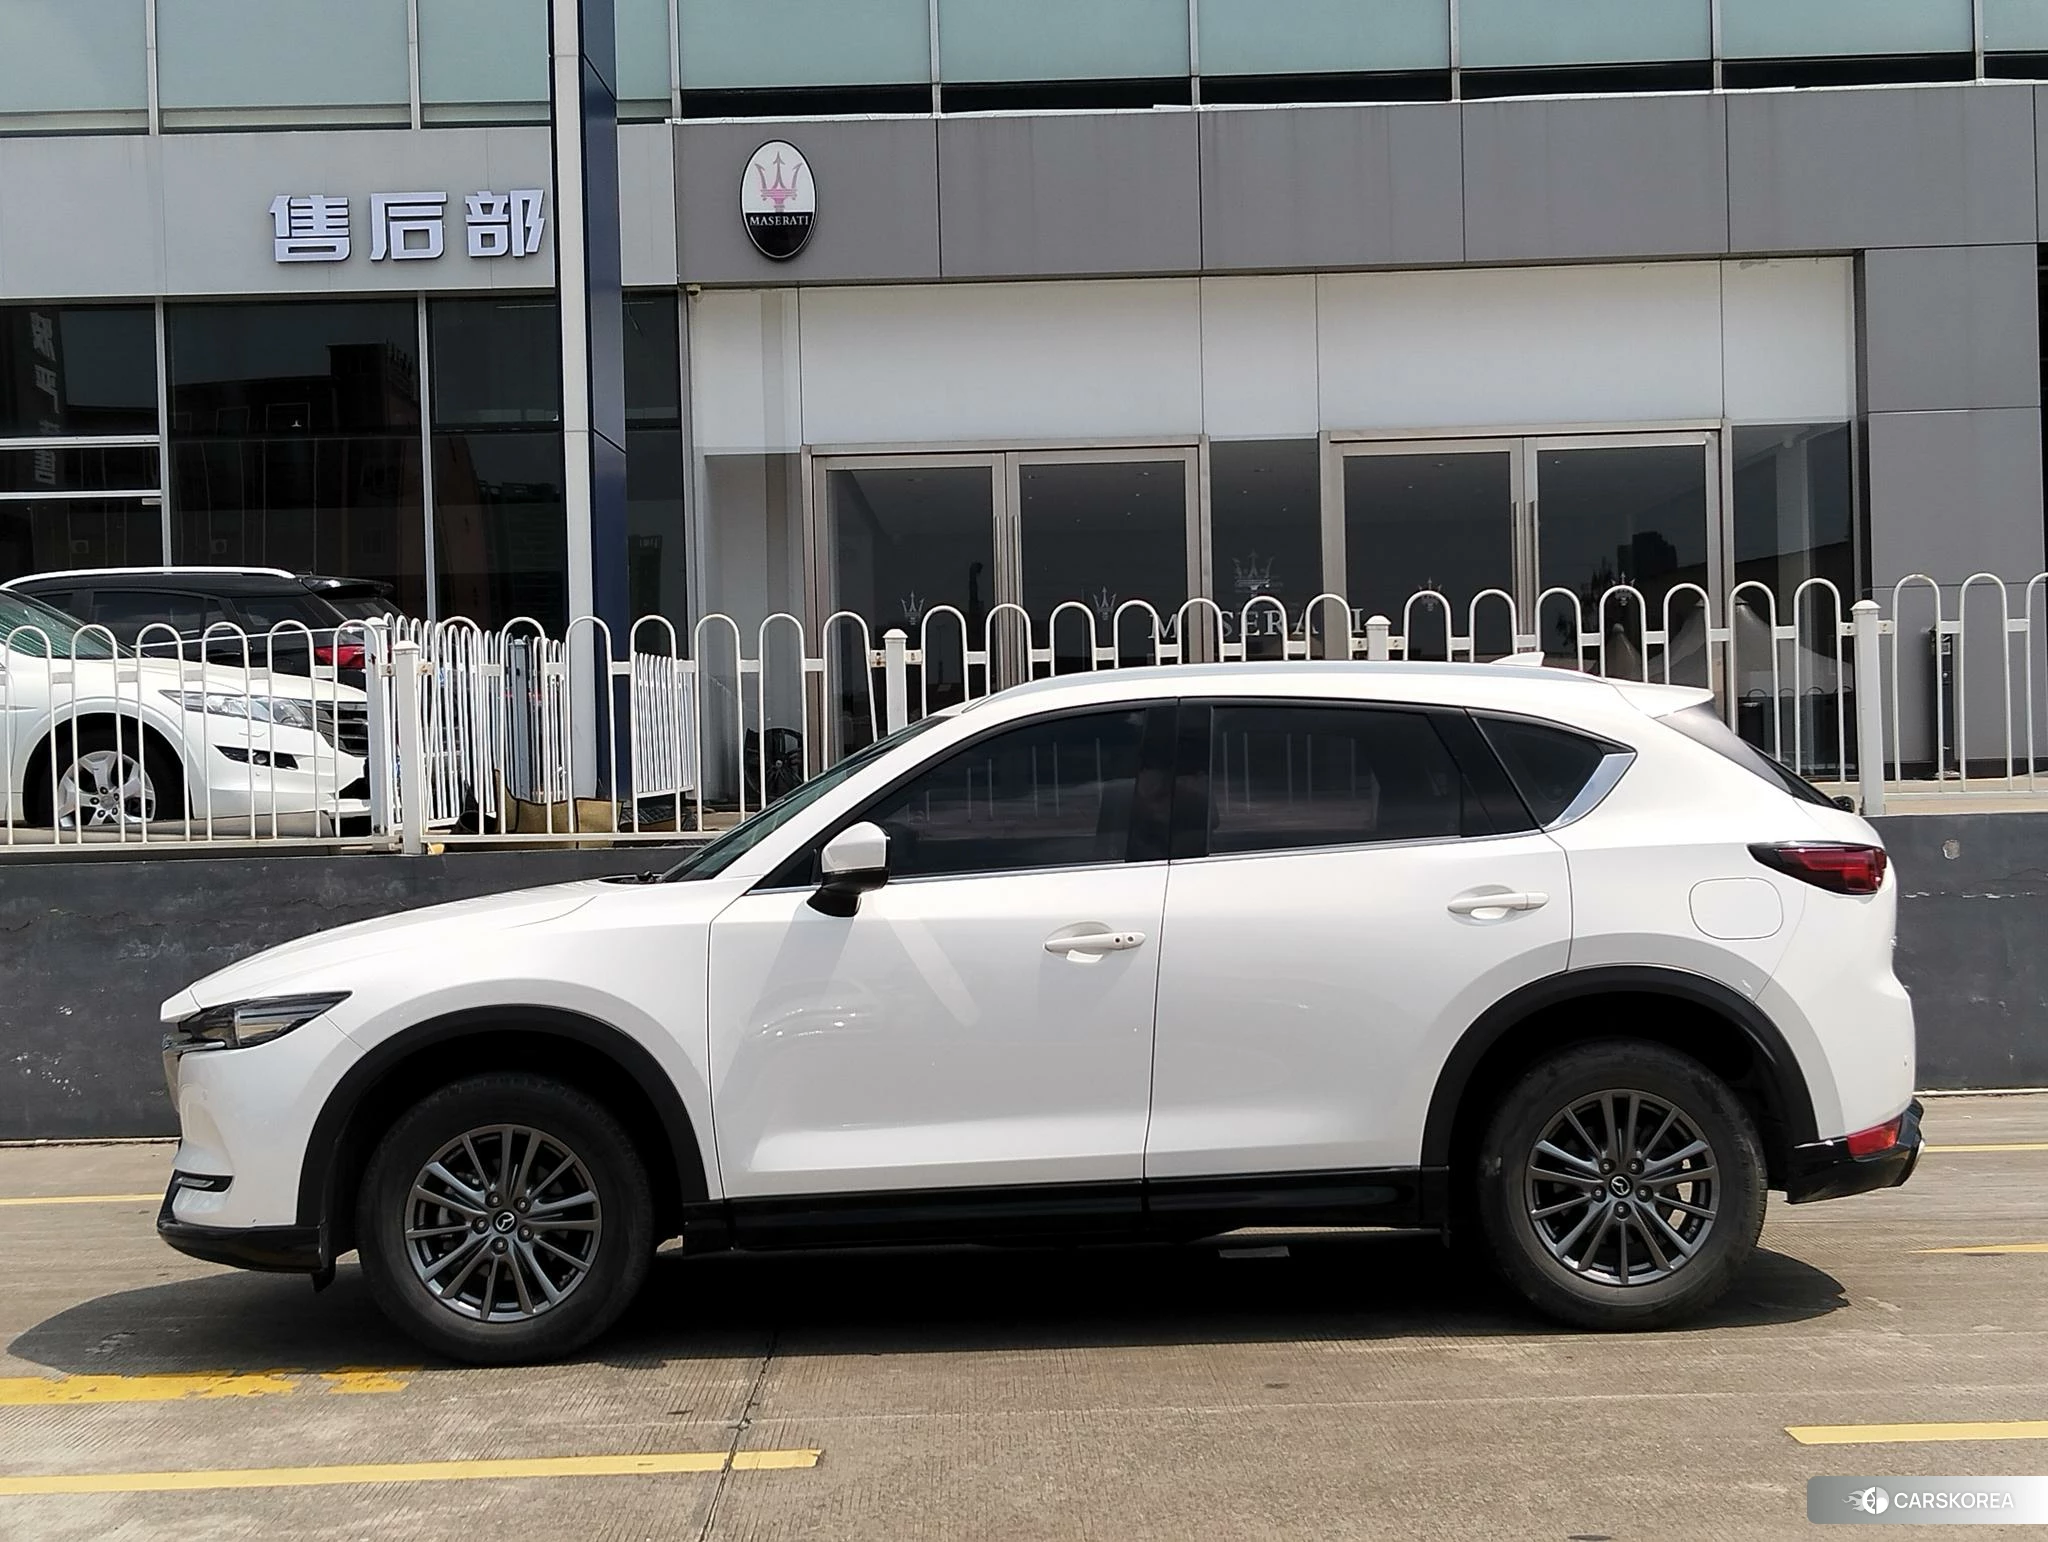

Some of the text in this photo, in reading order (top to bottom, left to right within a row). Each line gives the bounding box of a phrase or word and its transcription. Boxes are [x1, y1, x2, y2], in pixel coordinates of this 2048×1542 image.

[269, 189, 546, 262] 售后部
[749, 215, 809, 226] MASERATI
[1148, 607, 1365, 639] MSERAI
